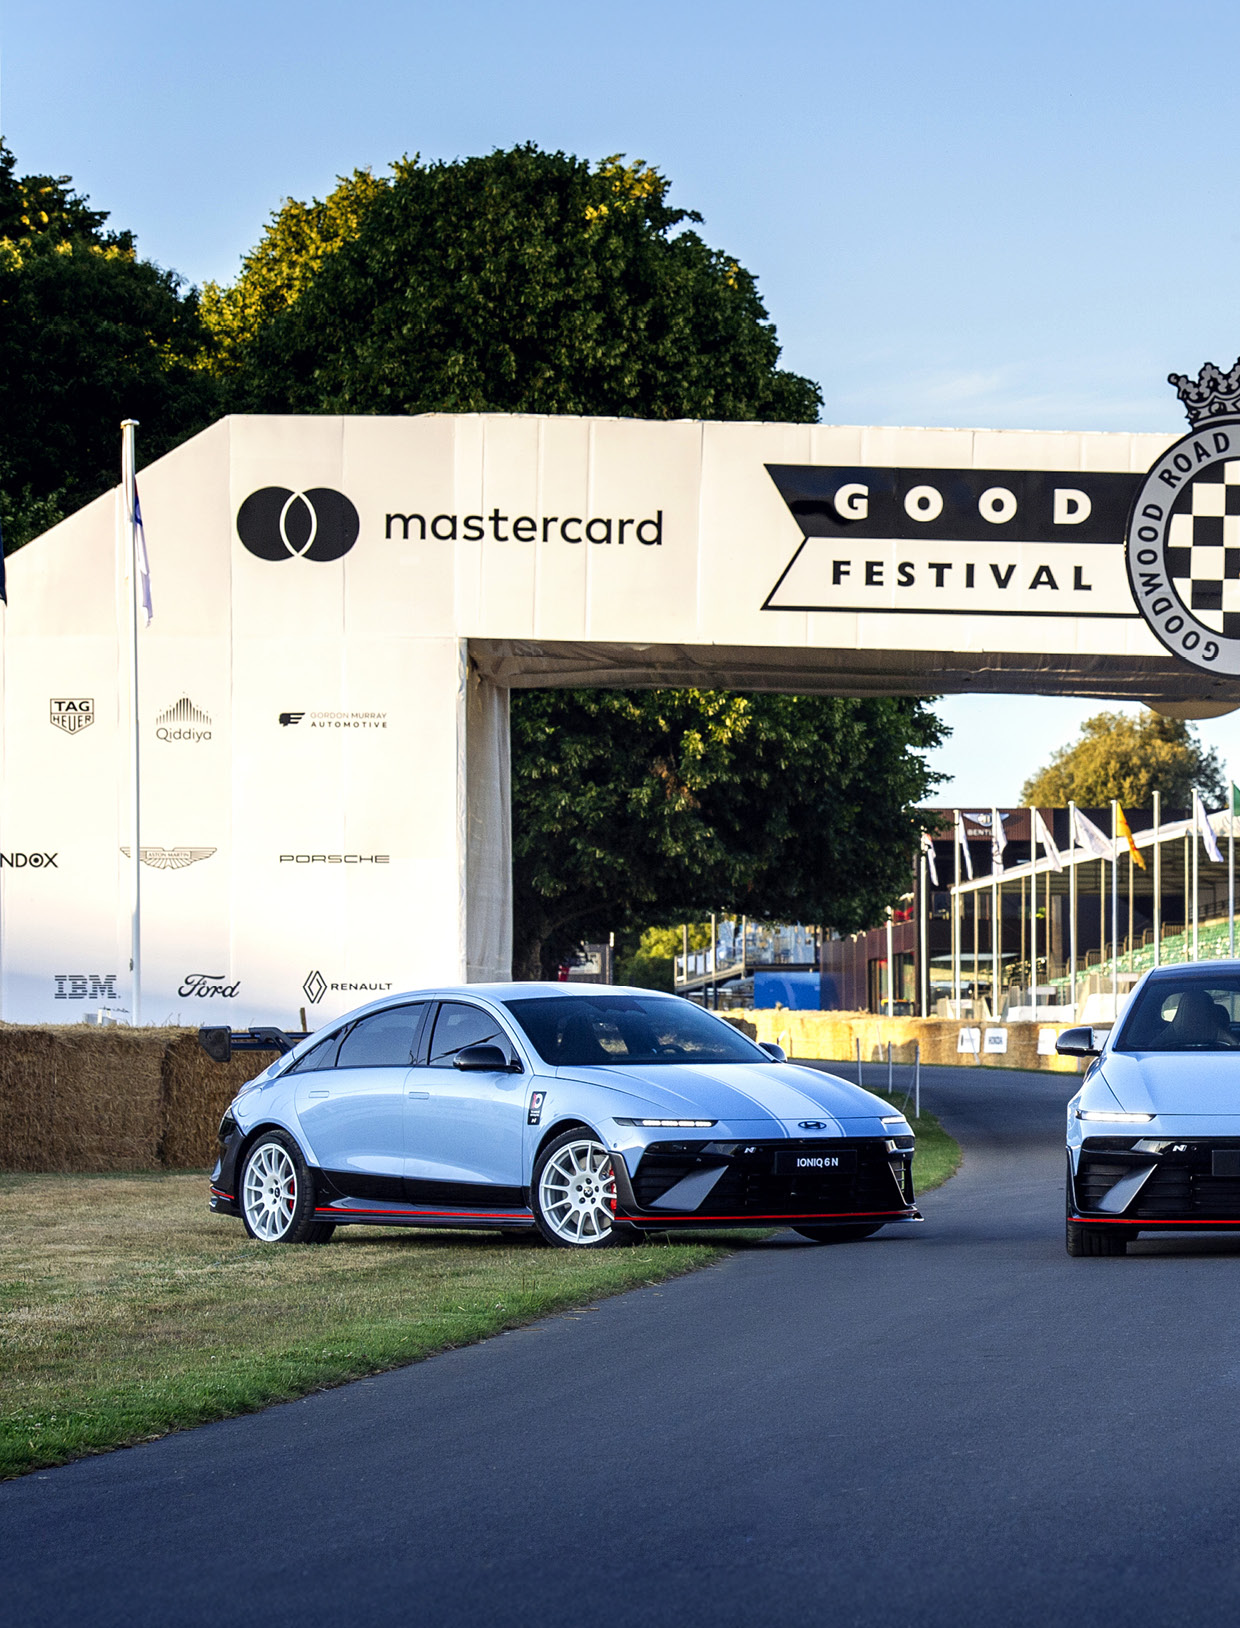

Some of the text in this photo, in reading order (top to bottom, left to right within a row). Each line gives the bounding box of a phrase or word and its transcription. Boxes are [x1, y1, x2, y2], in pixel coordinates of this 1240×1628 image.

[1158, 432, 1231, 489] ROAD
[833, 483, 1092, 525] GOOD
[385, 509, 663, 546] mastercard
[832, 559, 1093, 592] FESTIVAL
[1137, 504, 1220, 661] GOODWOOD
[54, 701, 90, 712] TAG
[310, 711, 349, 719] GORDON
[52, 714, 92, 731] HEUER
[156, 727, 212, 743] Qiddiya
[280, 854, 390, 864] PORSCHE
[54, 974, 117, 1000] IBM
[177, 973, 241, 999] Ford
[330, 982, 393, 991] RENAULT
[797, 1158, 839, 1168] IONIQ 6 N
